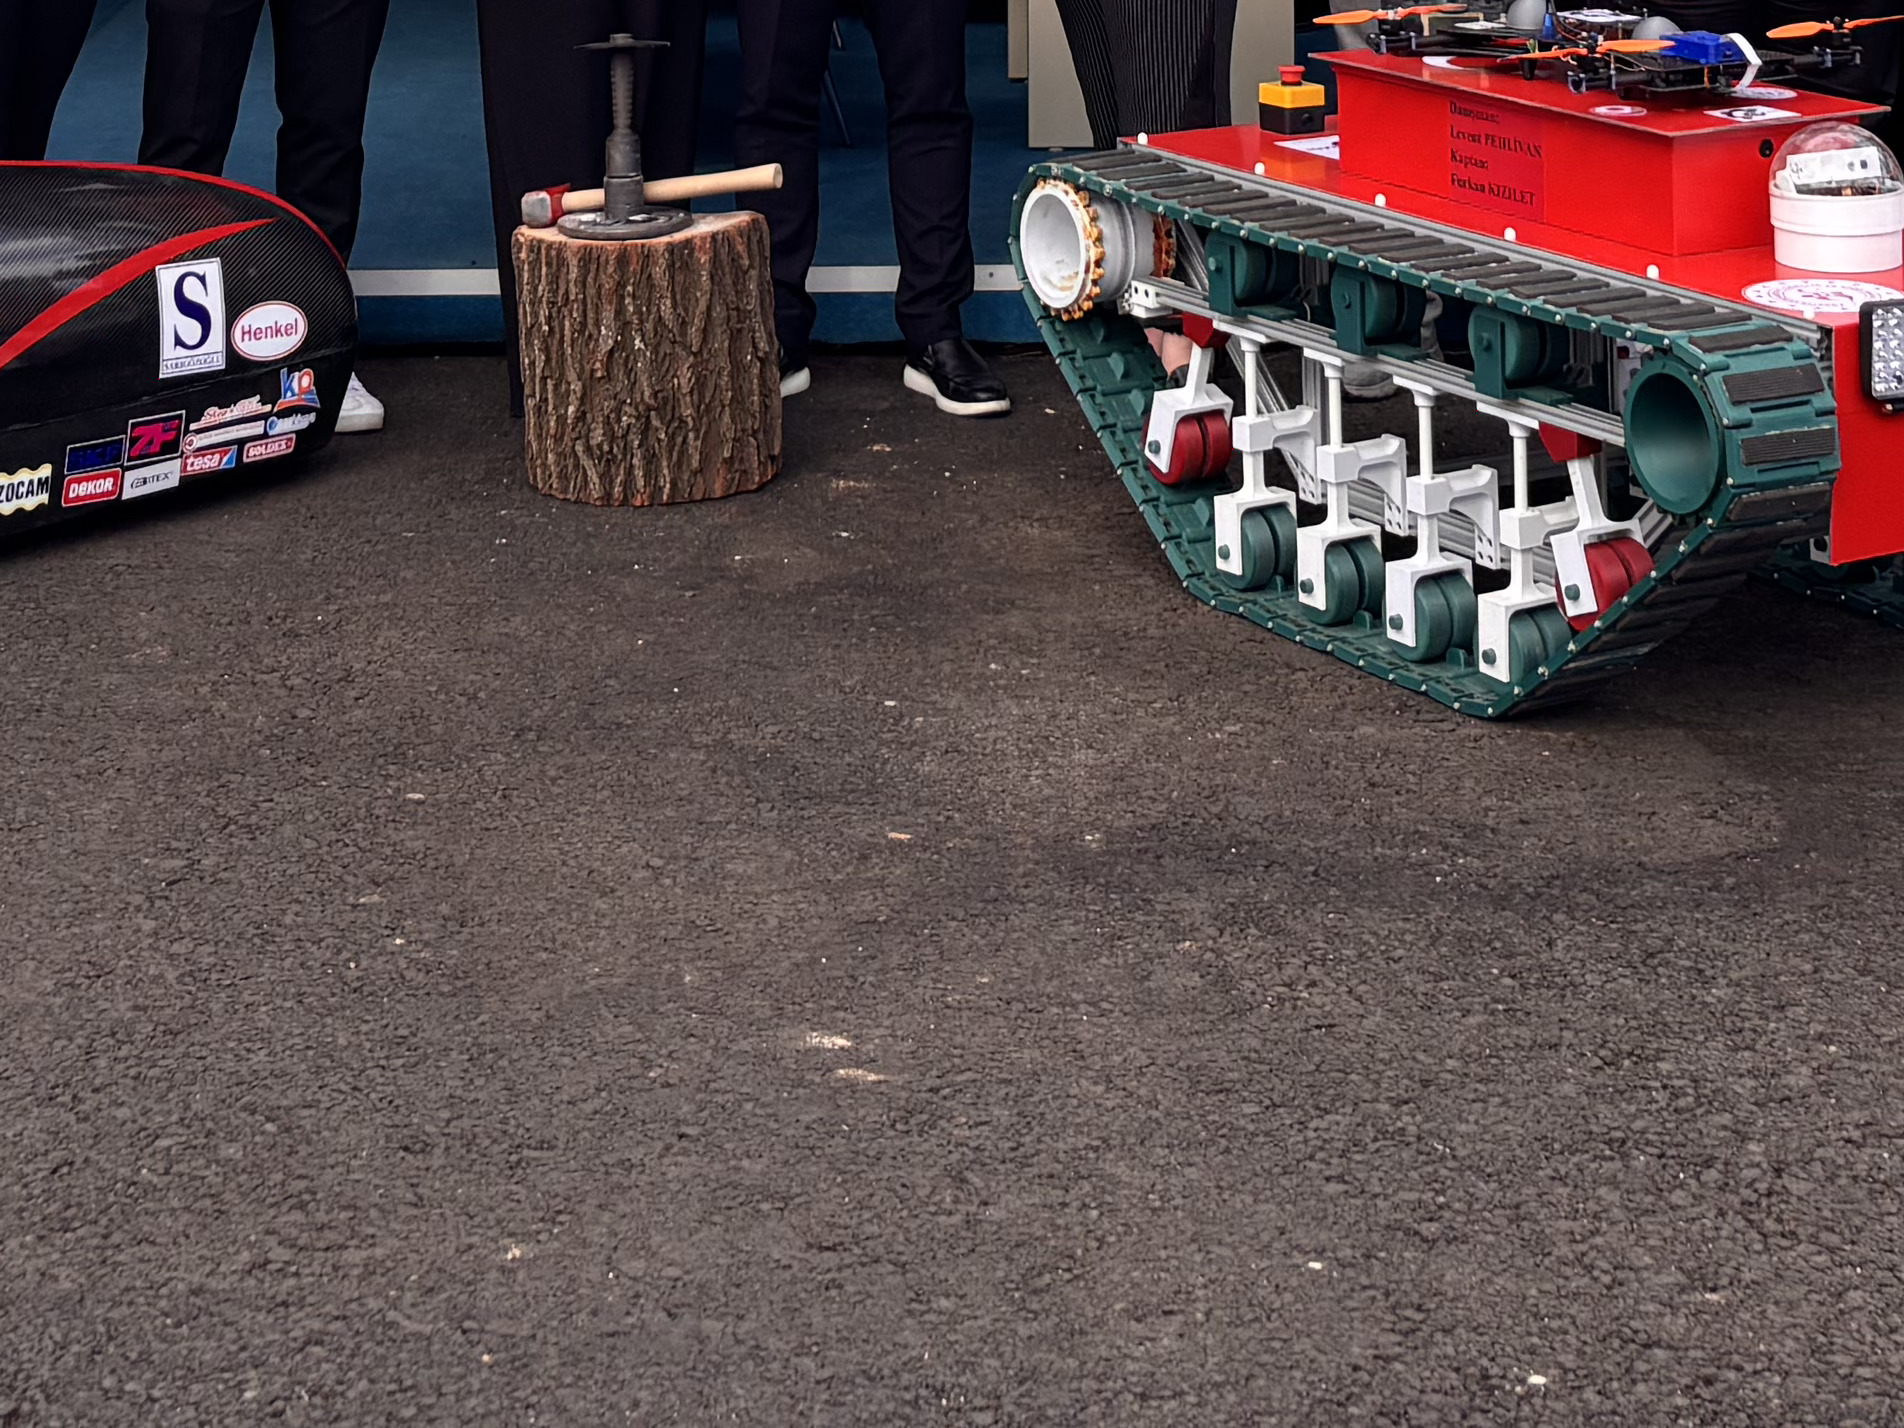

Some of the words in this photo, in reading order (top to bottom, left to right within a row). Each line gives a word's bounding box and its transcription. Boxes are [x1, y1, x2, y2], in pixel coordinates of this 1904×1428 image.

[174, 271, 212, 351] S
[241, 317, 298, 343] Henkel
[186, 452, 221, 471] tesa
